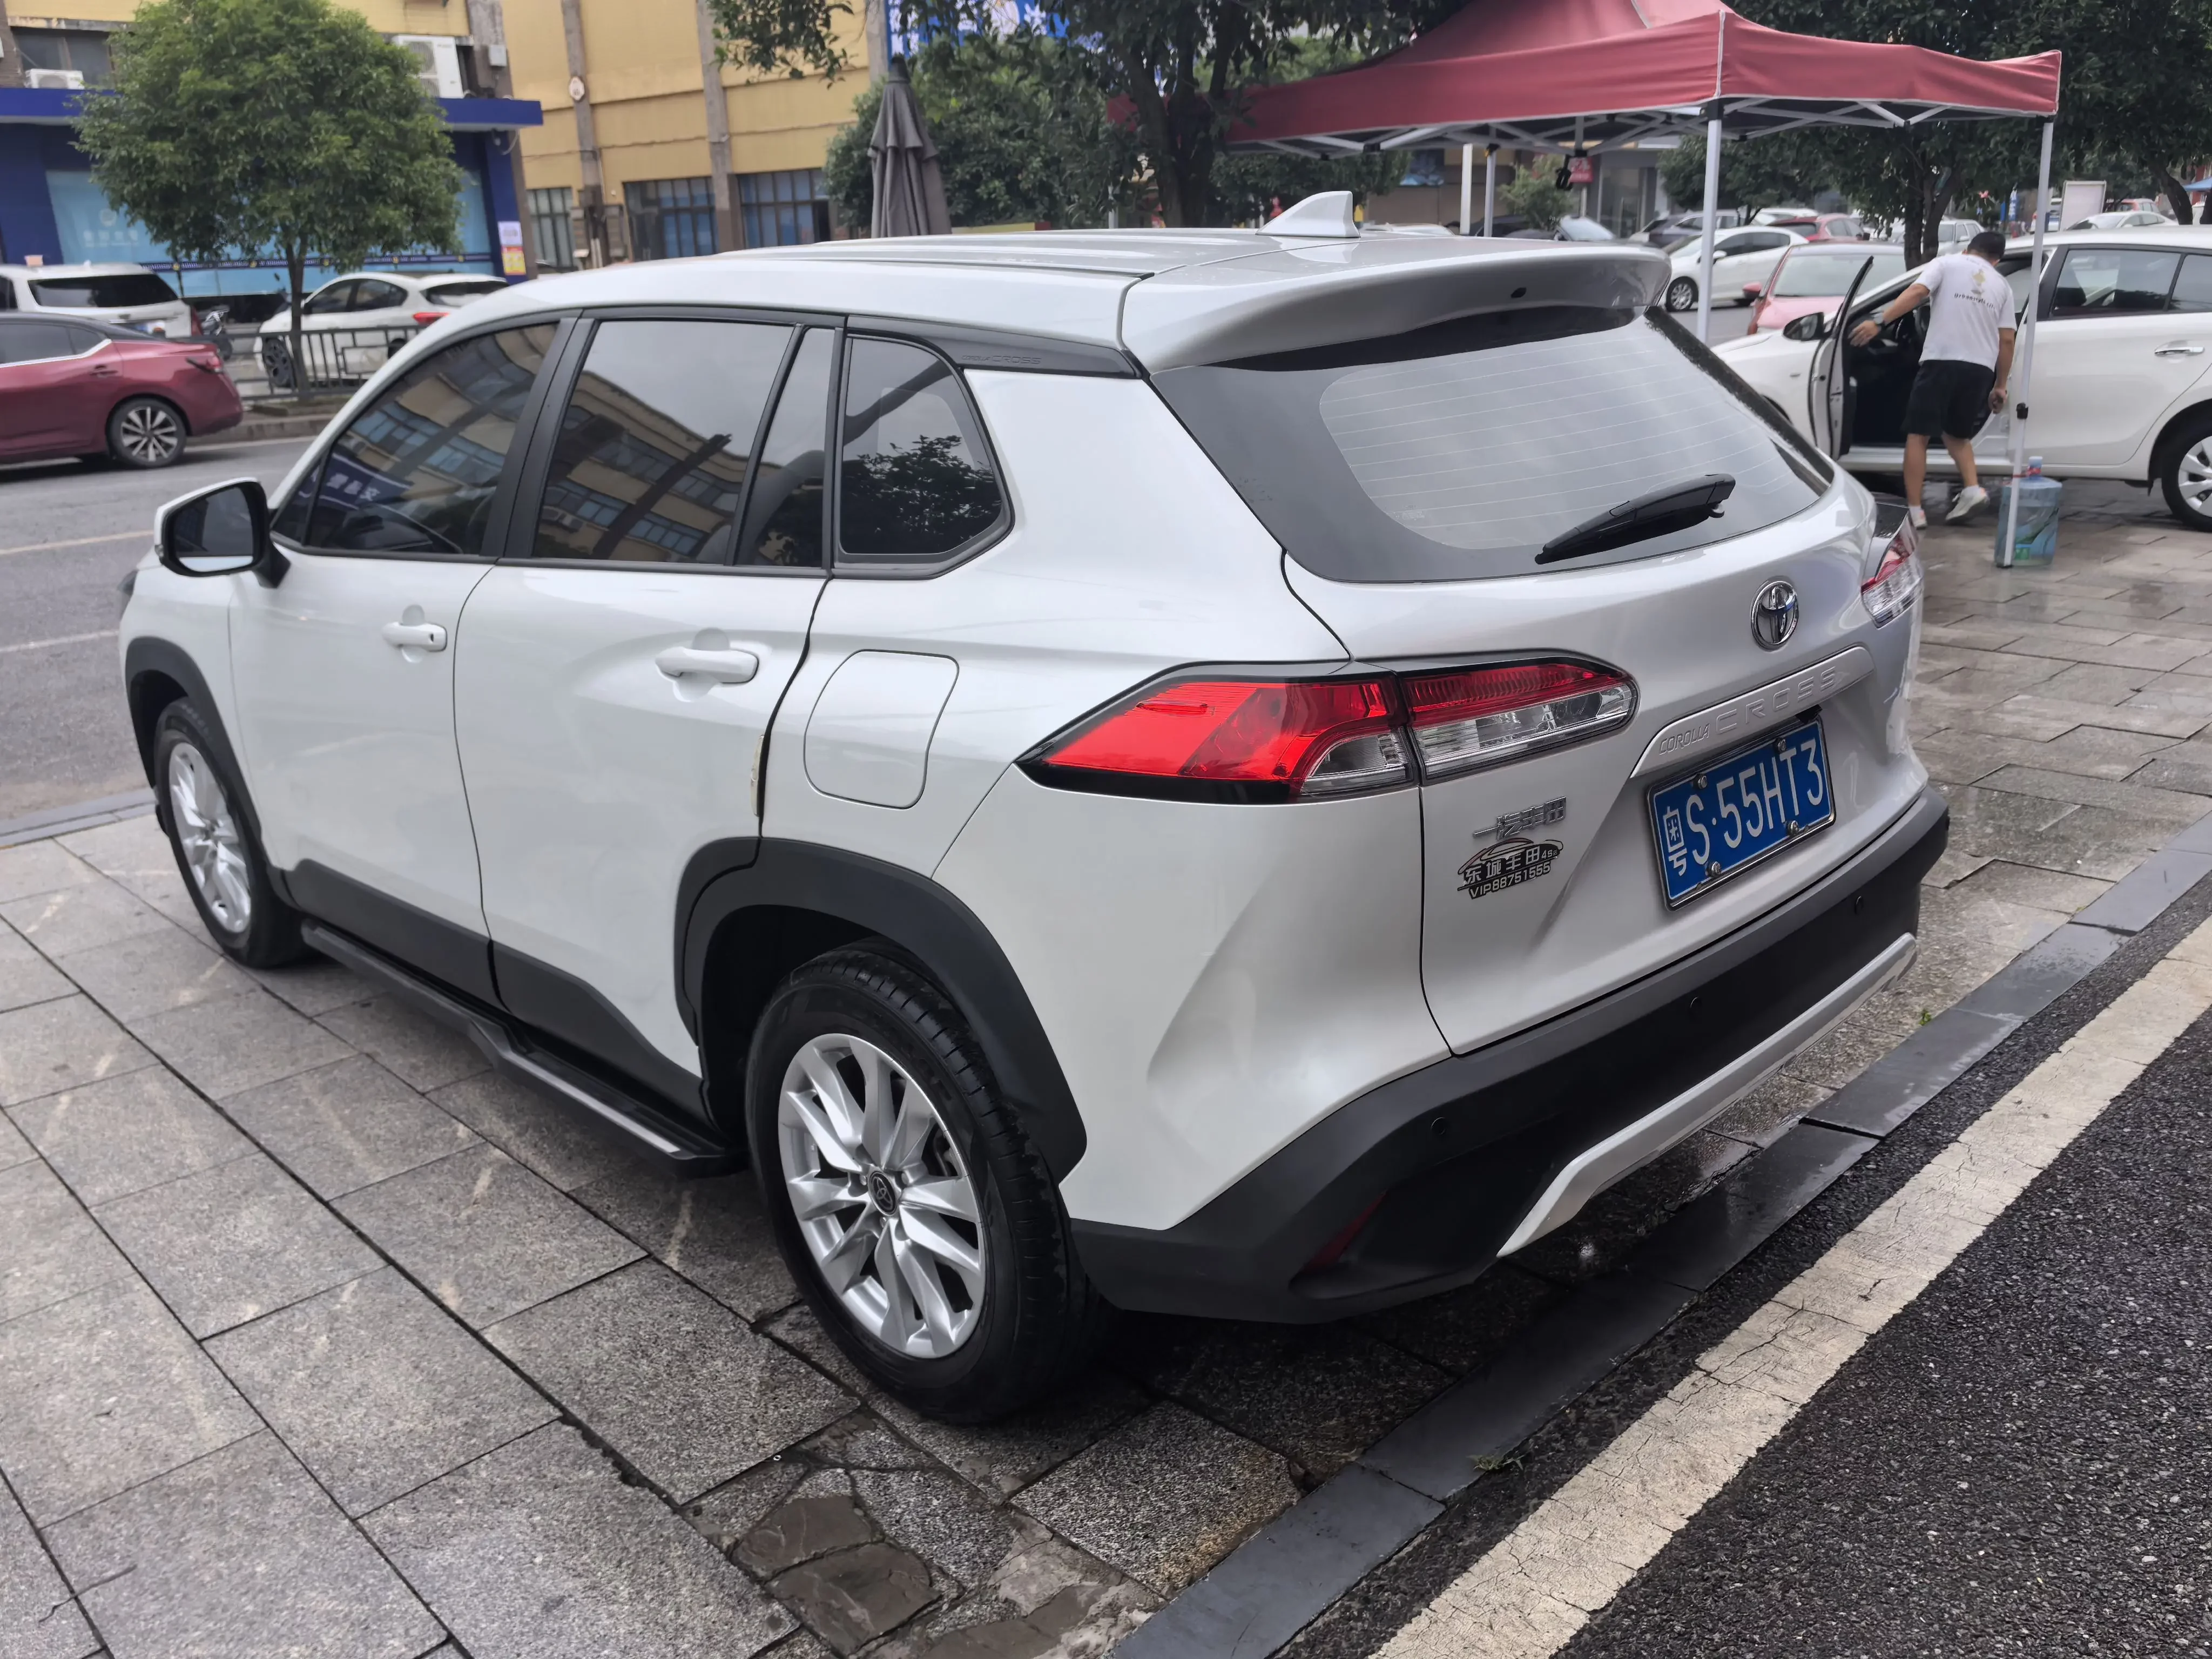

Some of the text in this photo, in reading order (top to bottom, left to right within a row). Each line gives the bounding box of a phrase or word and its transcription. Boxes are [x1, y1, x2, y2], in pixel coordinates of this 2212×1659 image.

[992, 355, 1042, 365] CROSS
[1659, 665, 1837, 756] COROLLA CROSS
[1473, 795, 1567, 840] 一汽丰田
[1469, 861, 1551, 899] VIP88751555
